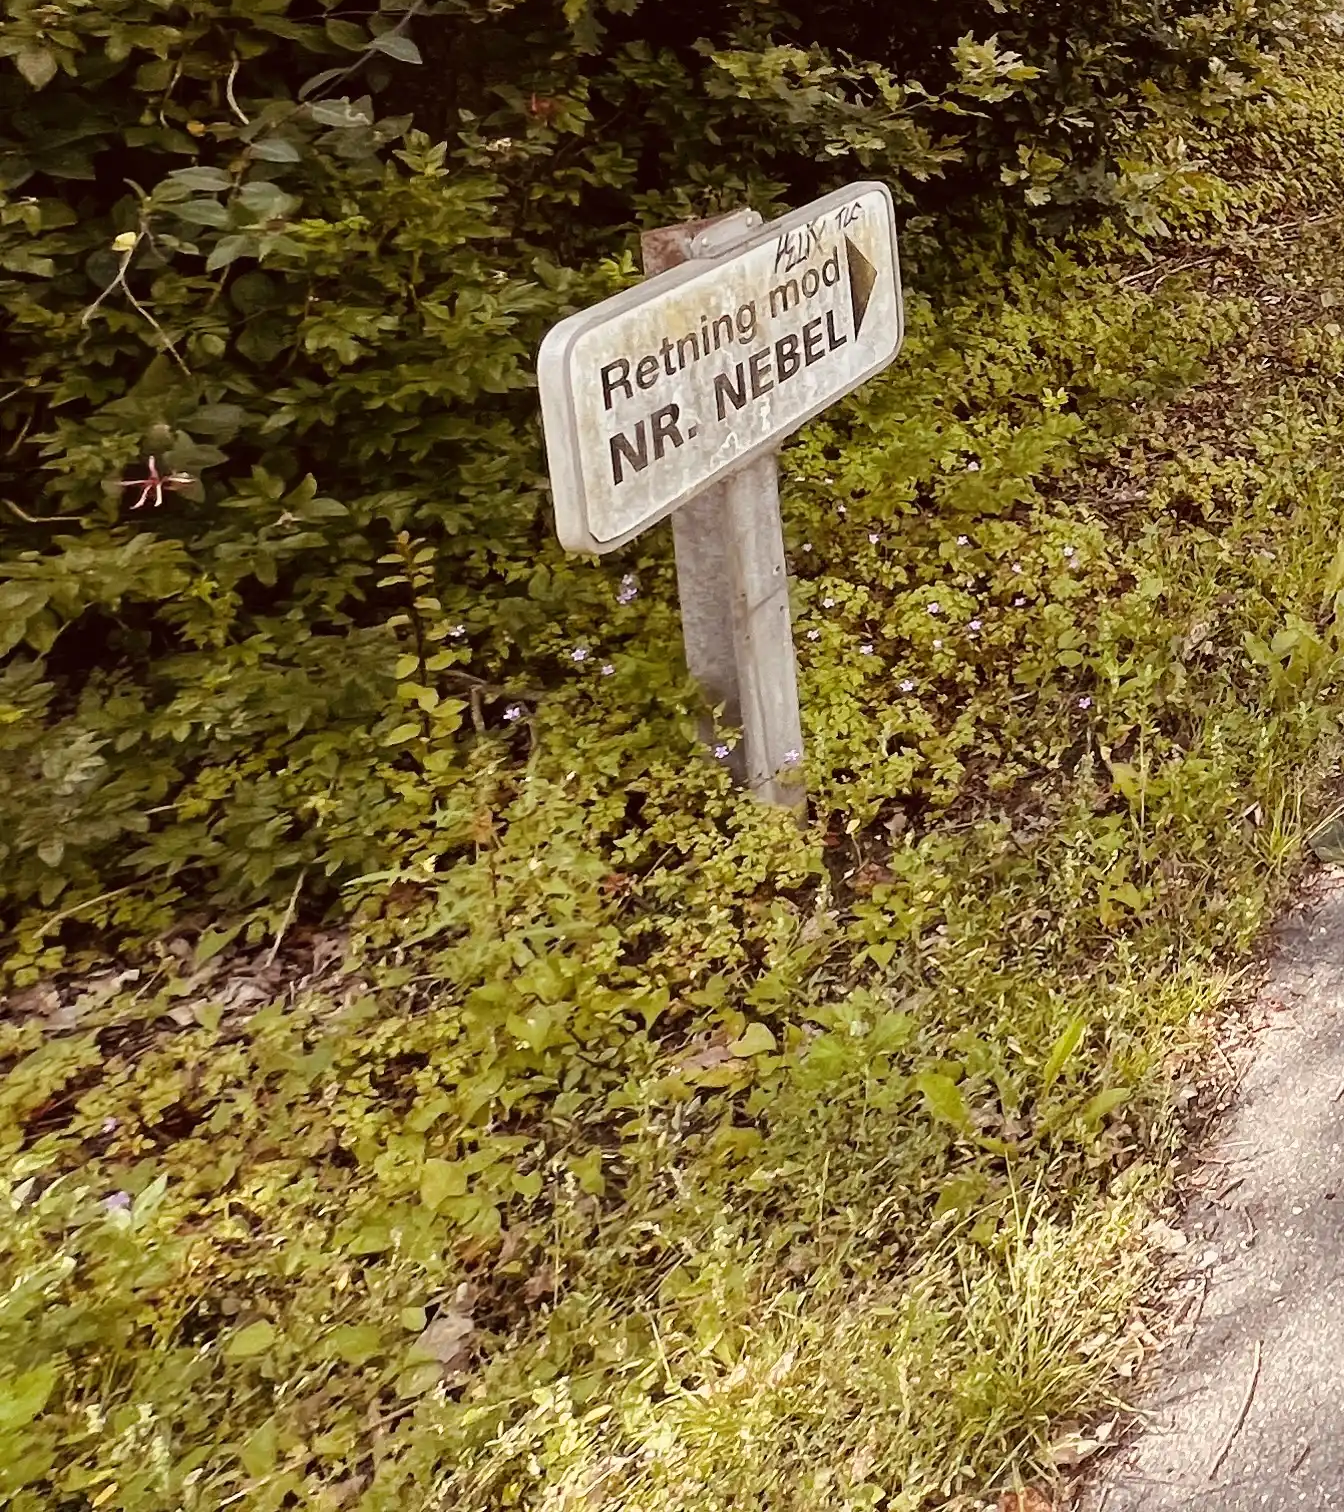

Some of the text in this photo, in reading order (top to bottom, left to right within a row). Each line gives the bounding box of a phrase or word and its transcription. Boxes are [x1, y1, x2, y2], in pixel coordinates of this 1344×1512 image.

[600, 246, 841, 410] Retning mod
[609, 309, 848, 486] NR. NEBEL
